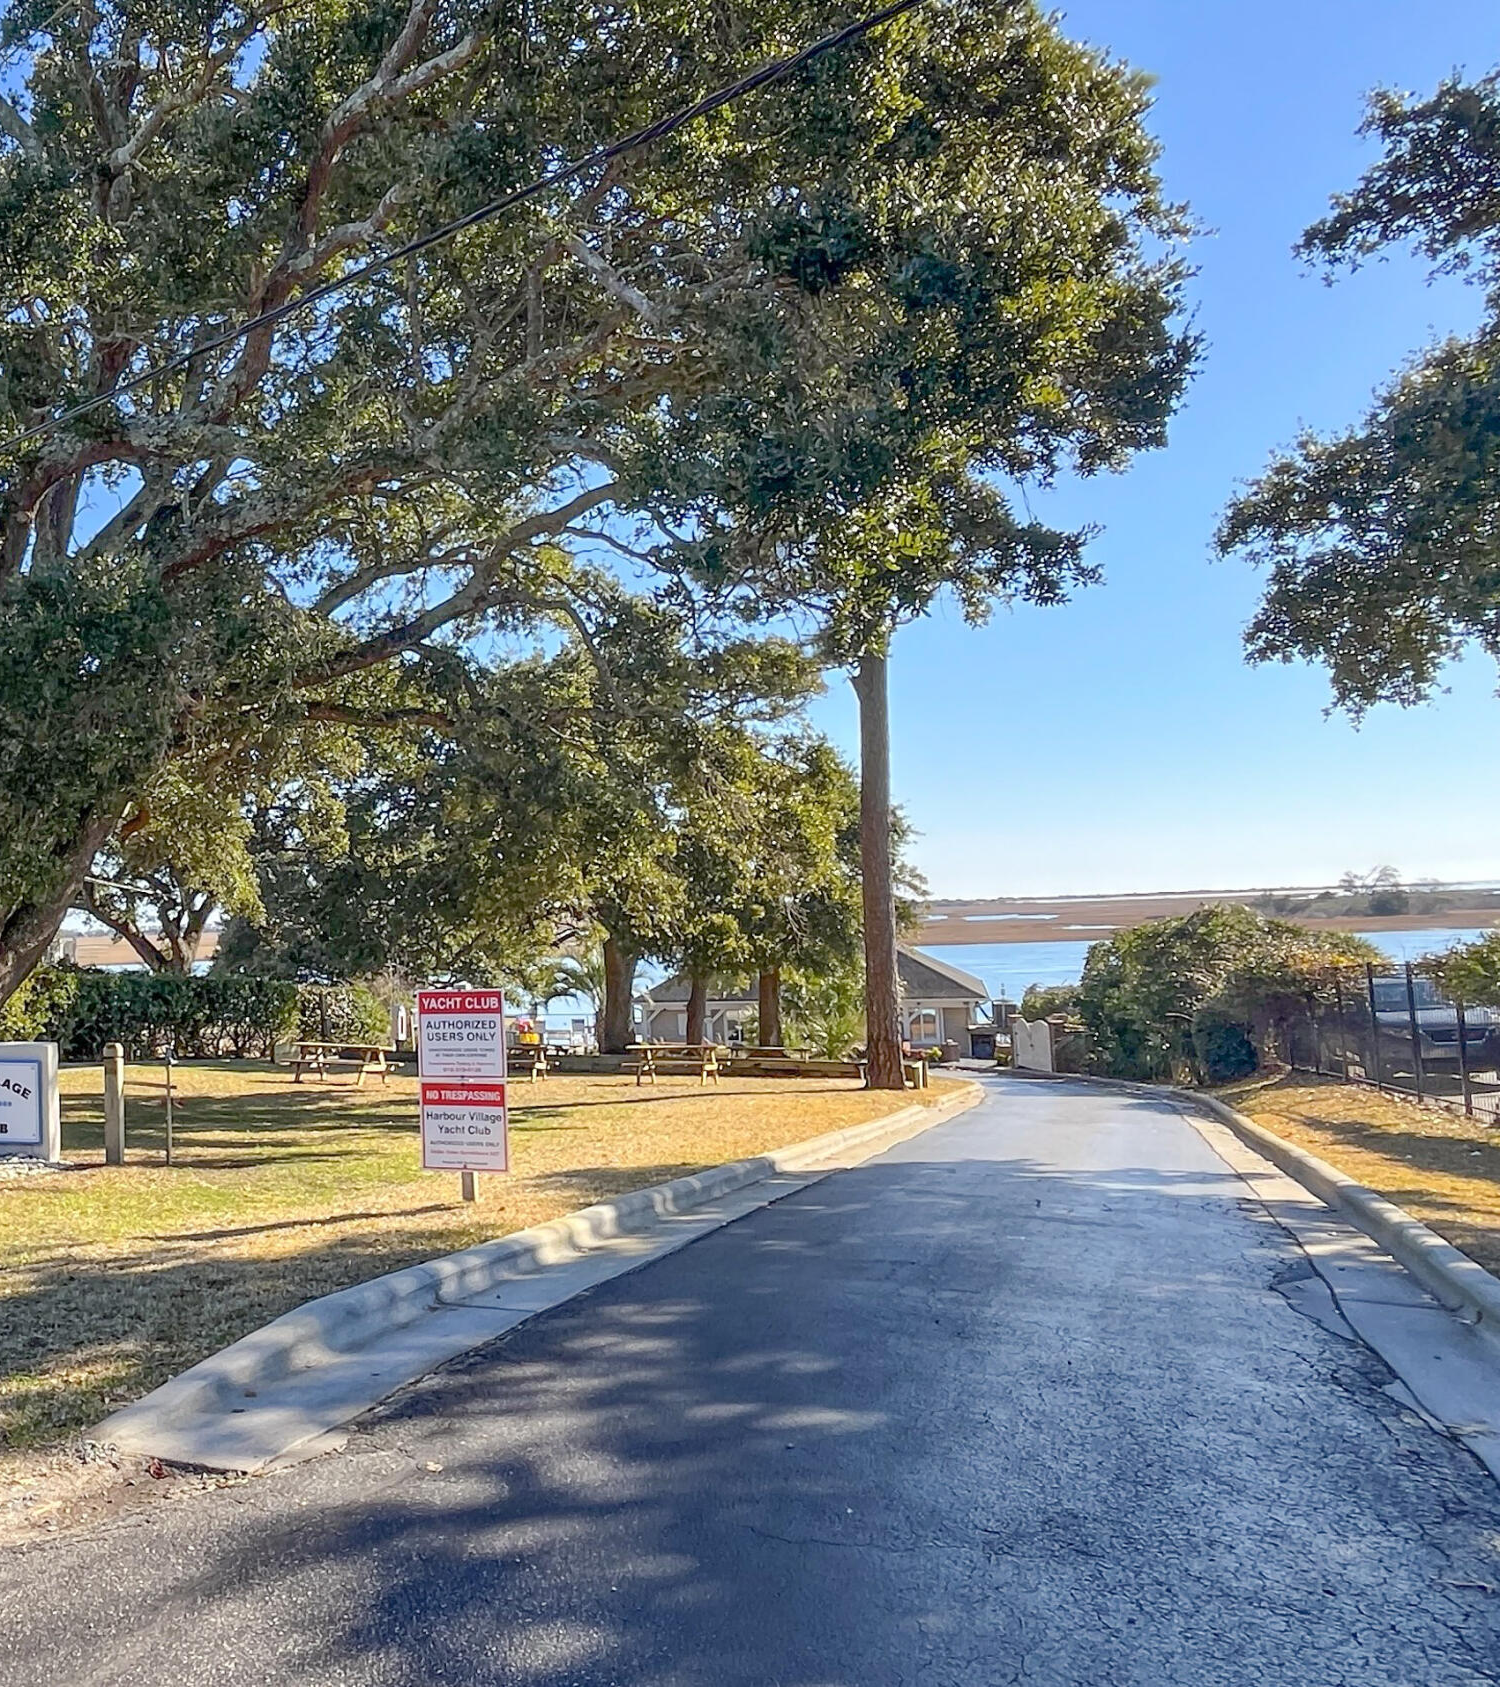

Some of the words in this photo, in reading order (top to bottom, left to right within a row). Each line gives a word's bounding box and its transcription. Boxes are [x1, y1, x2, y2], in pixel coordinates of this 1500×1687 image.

[421, 997, 462, 1010] YACHT
[464, 997, 499, 1009] CLUB
[426, 1020, 497, 1030] AUTHORIZED
[427, 1032, 464, 1041] USERS
[466, 1032, 496, 1041] ONLY
[425, 1090, 439, 1100] NO
[440, 1090, 501, 1101] TRESPASSING
[426, 1111, 466, 1120] Harbour
[468, 1111, 502, 1124] Village
[437, 1124, 465, 1134] Yacht
[467, 1125, 491, 1135] Club
